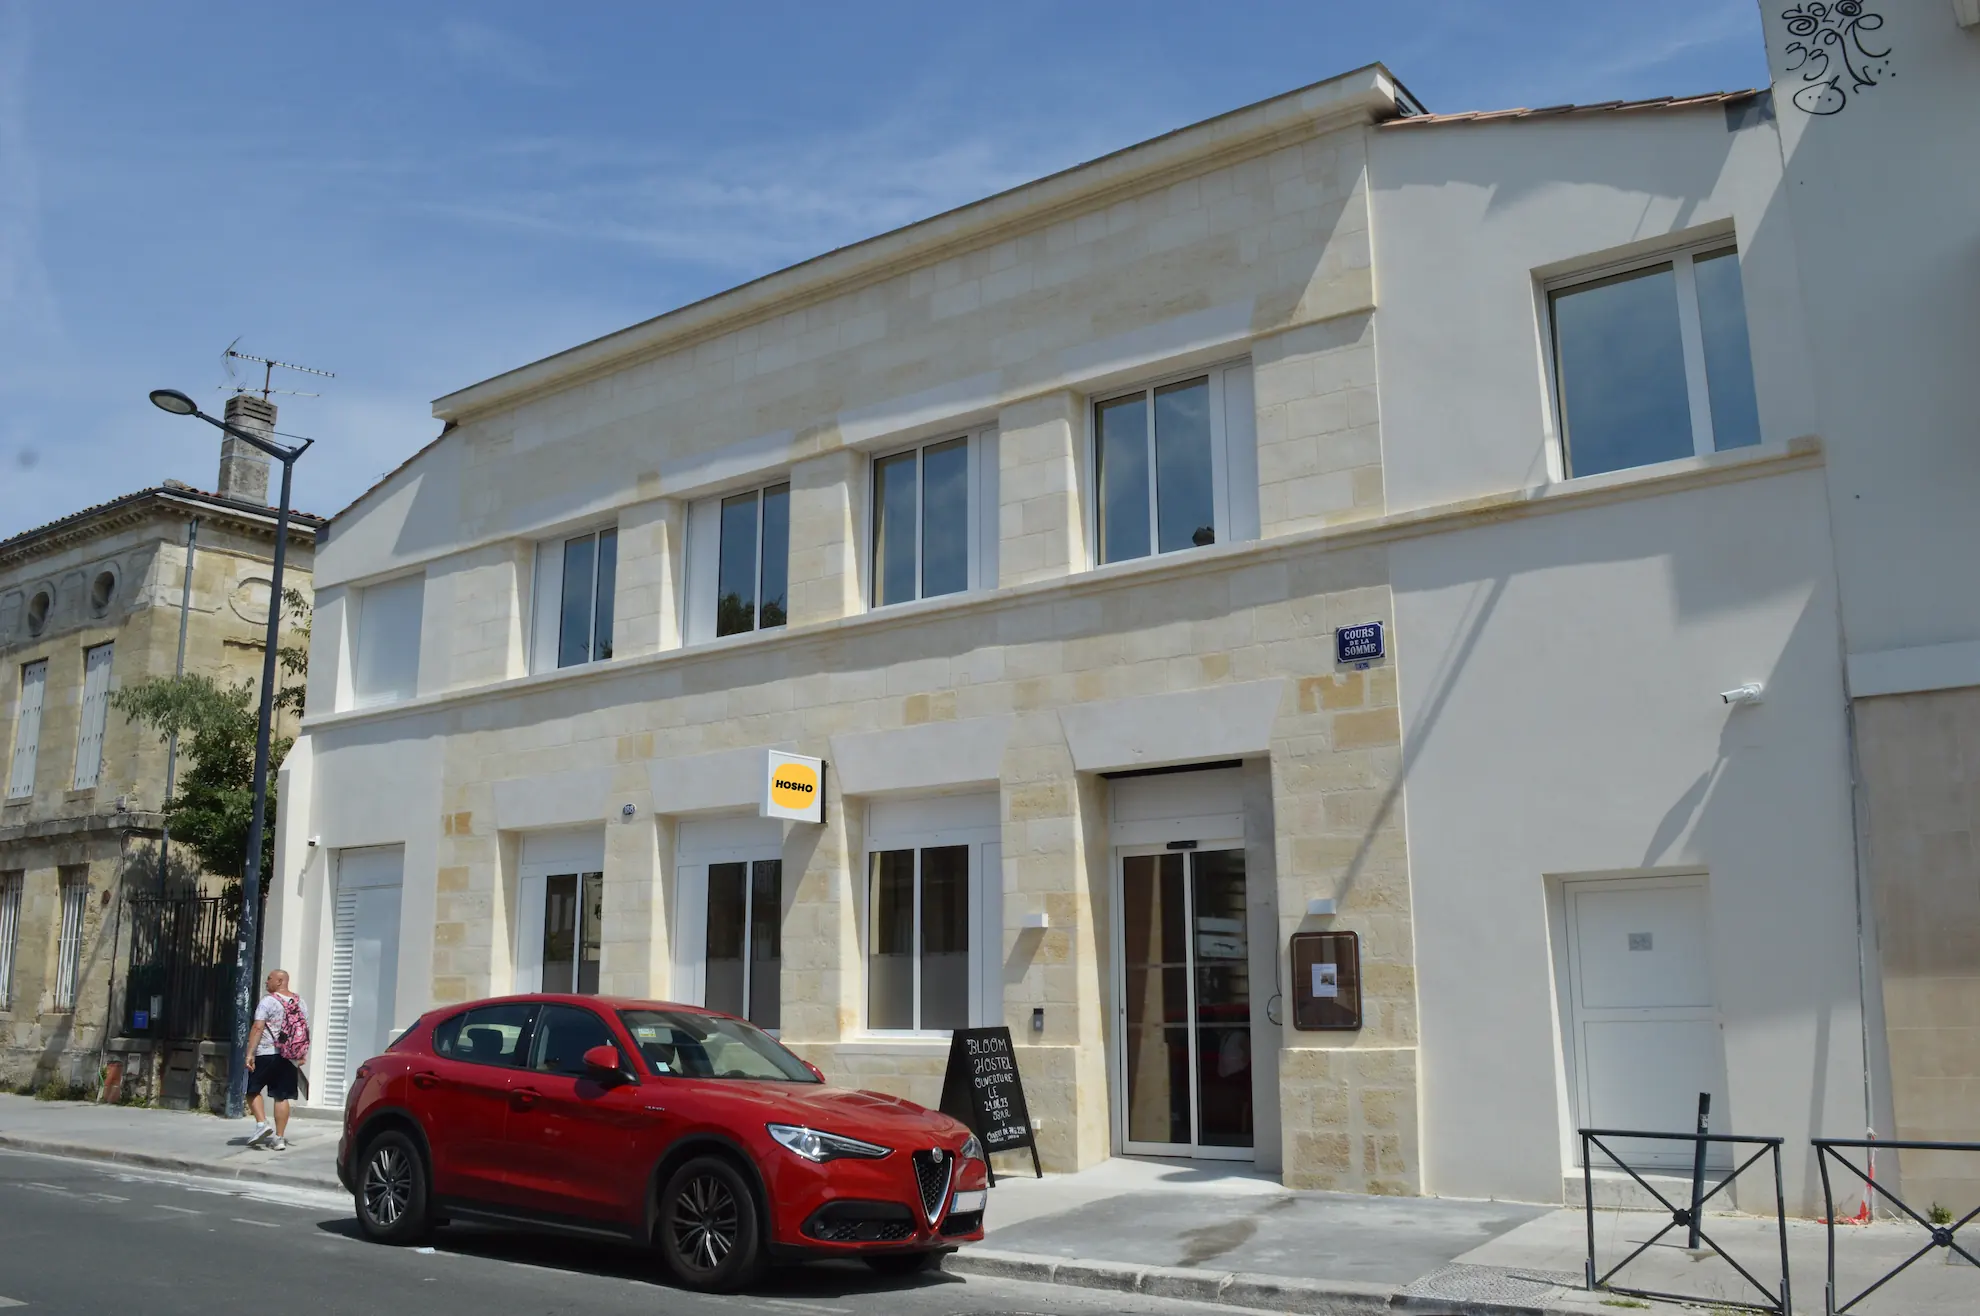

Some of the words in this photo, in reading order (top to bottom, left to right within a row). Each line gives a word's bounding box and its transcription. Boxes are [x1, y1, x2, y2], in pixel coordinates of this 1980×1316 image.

[1344, 628, 1375, 640] COURS
[1344, 643, 1377, 656] SOMME
[775, 780, 813, 793] HOSHO
[966, 1038, 1008, 1055] BLOOM
[974, 1056, 1013, 1074] HOSTEL
[974, 1073, 1014, 1088] OUVERTURE
[987, 1086, 999, 1099] LE
[992, 1109, 1011, 1120] BAR
